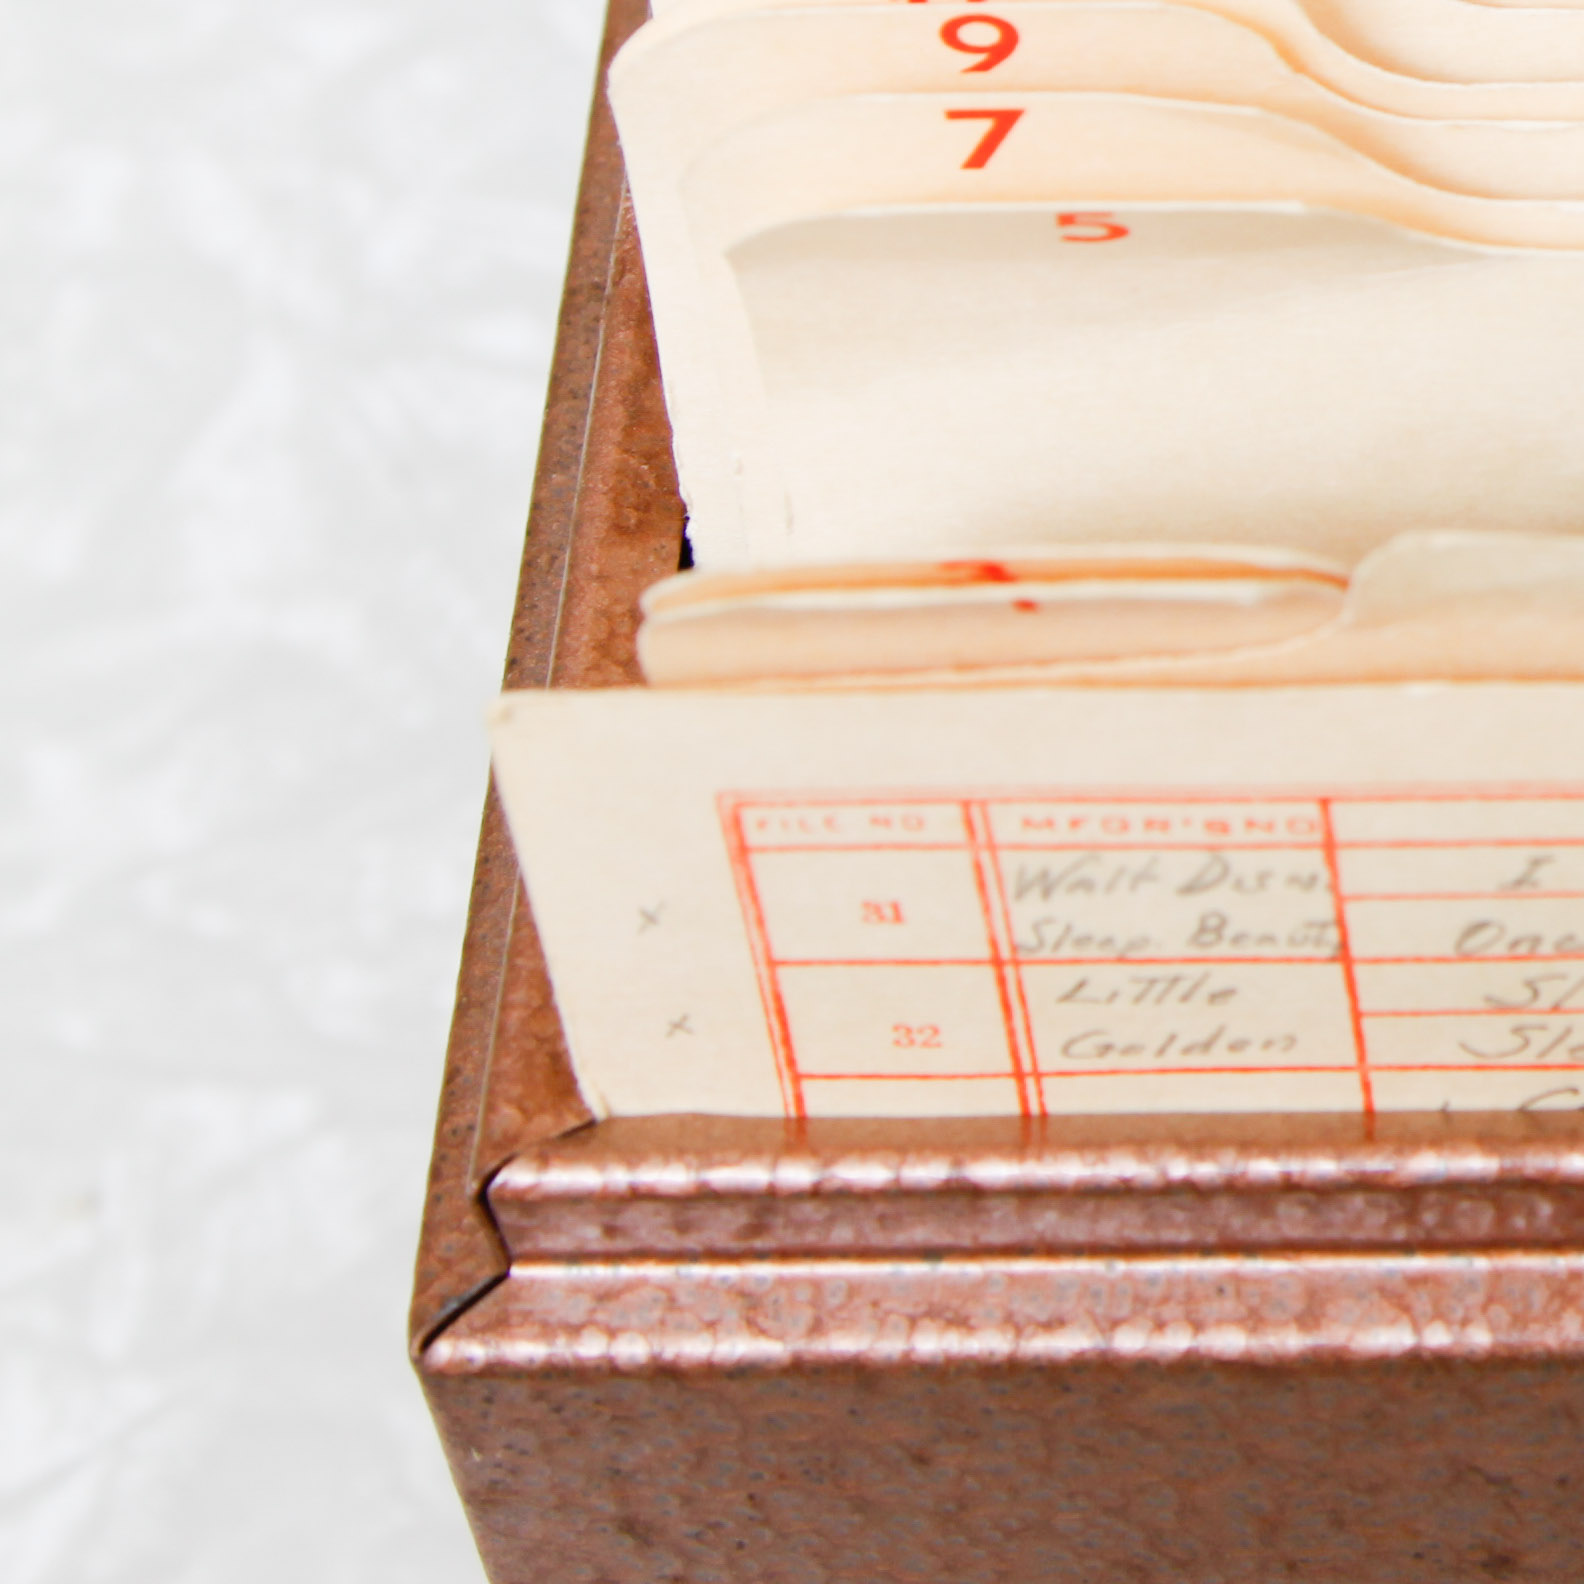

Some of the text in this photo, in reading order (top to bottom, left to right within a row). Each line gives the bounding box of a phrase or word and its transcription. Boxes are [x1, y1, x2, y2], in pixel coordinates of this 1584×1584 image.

[938, 13, 1021, 74] 9
[944, 108, 1026, 170] 7
[1055, 212, 1131, 243] 5
[890, 1022, 943, 1049] 32
[1059, 1026, 1300, 1062] Golden
